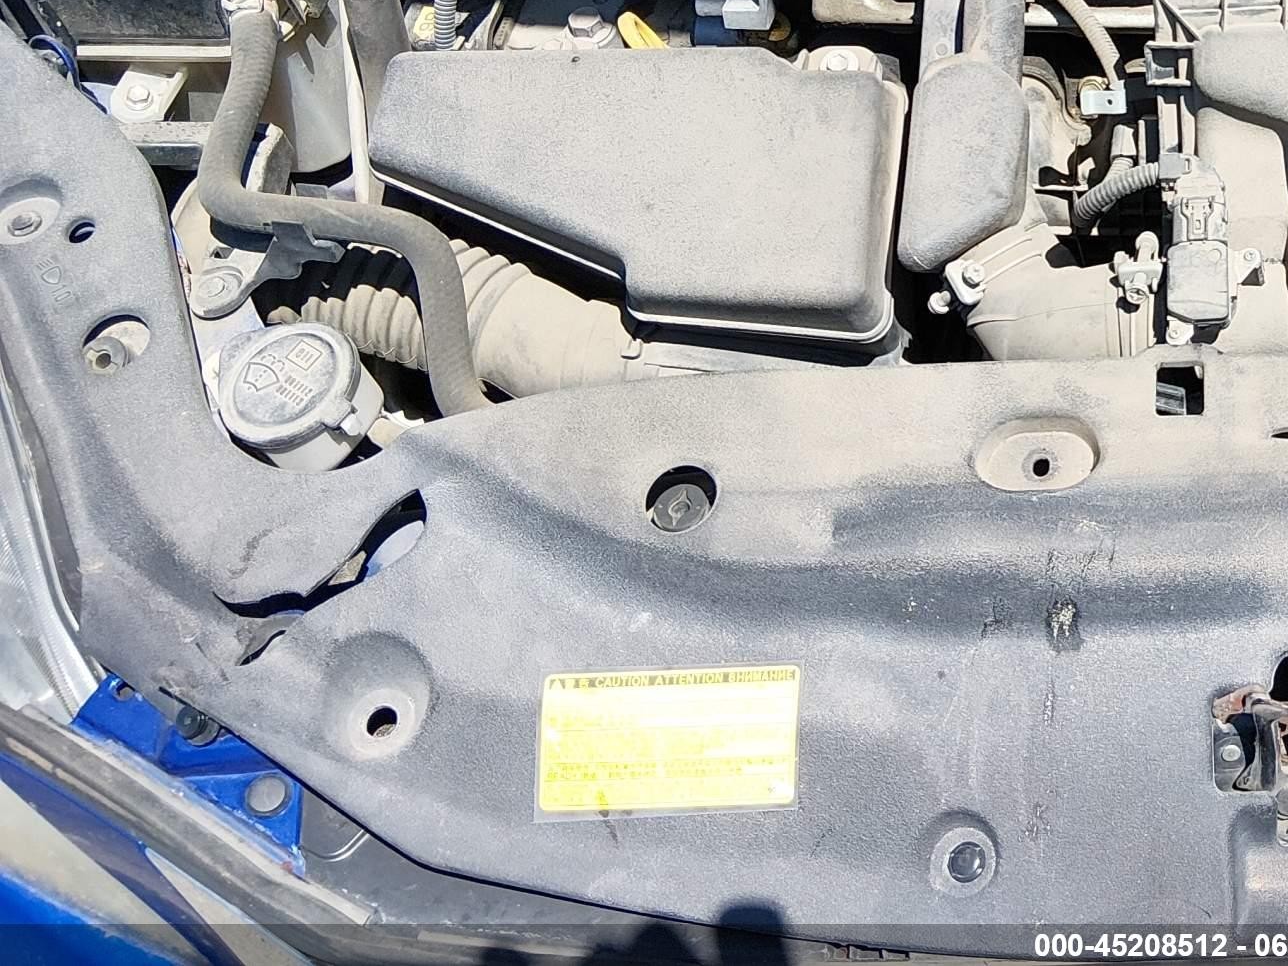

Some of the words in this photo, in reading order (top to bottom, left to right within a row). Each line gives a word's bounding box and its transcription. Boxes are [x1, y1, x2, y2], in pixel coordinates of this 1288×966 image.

[595, 675, 650, 688] CAUTION
[655, 672, 724, 686] ATTENTION
[728, 669, 794, 683] ВНИМАНИЕ
